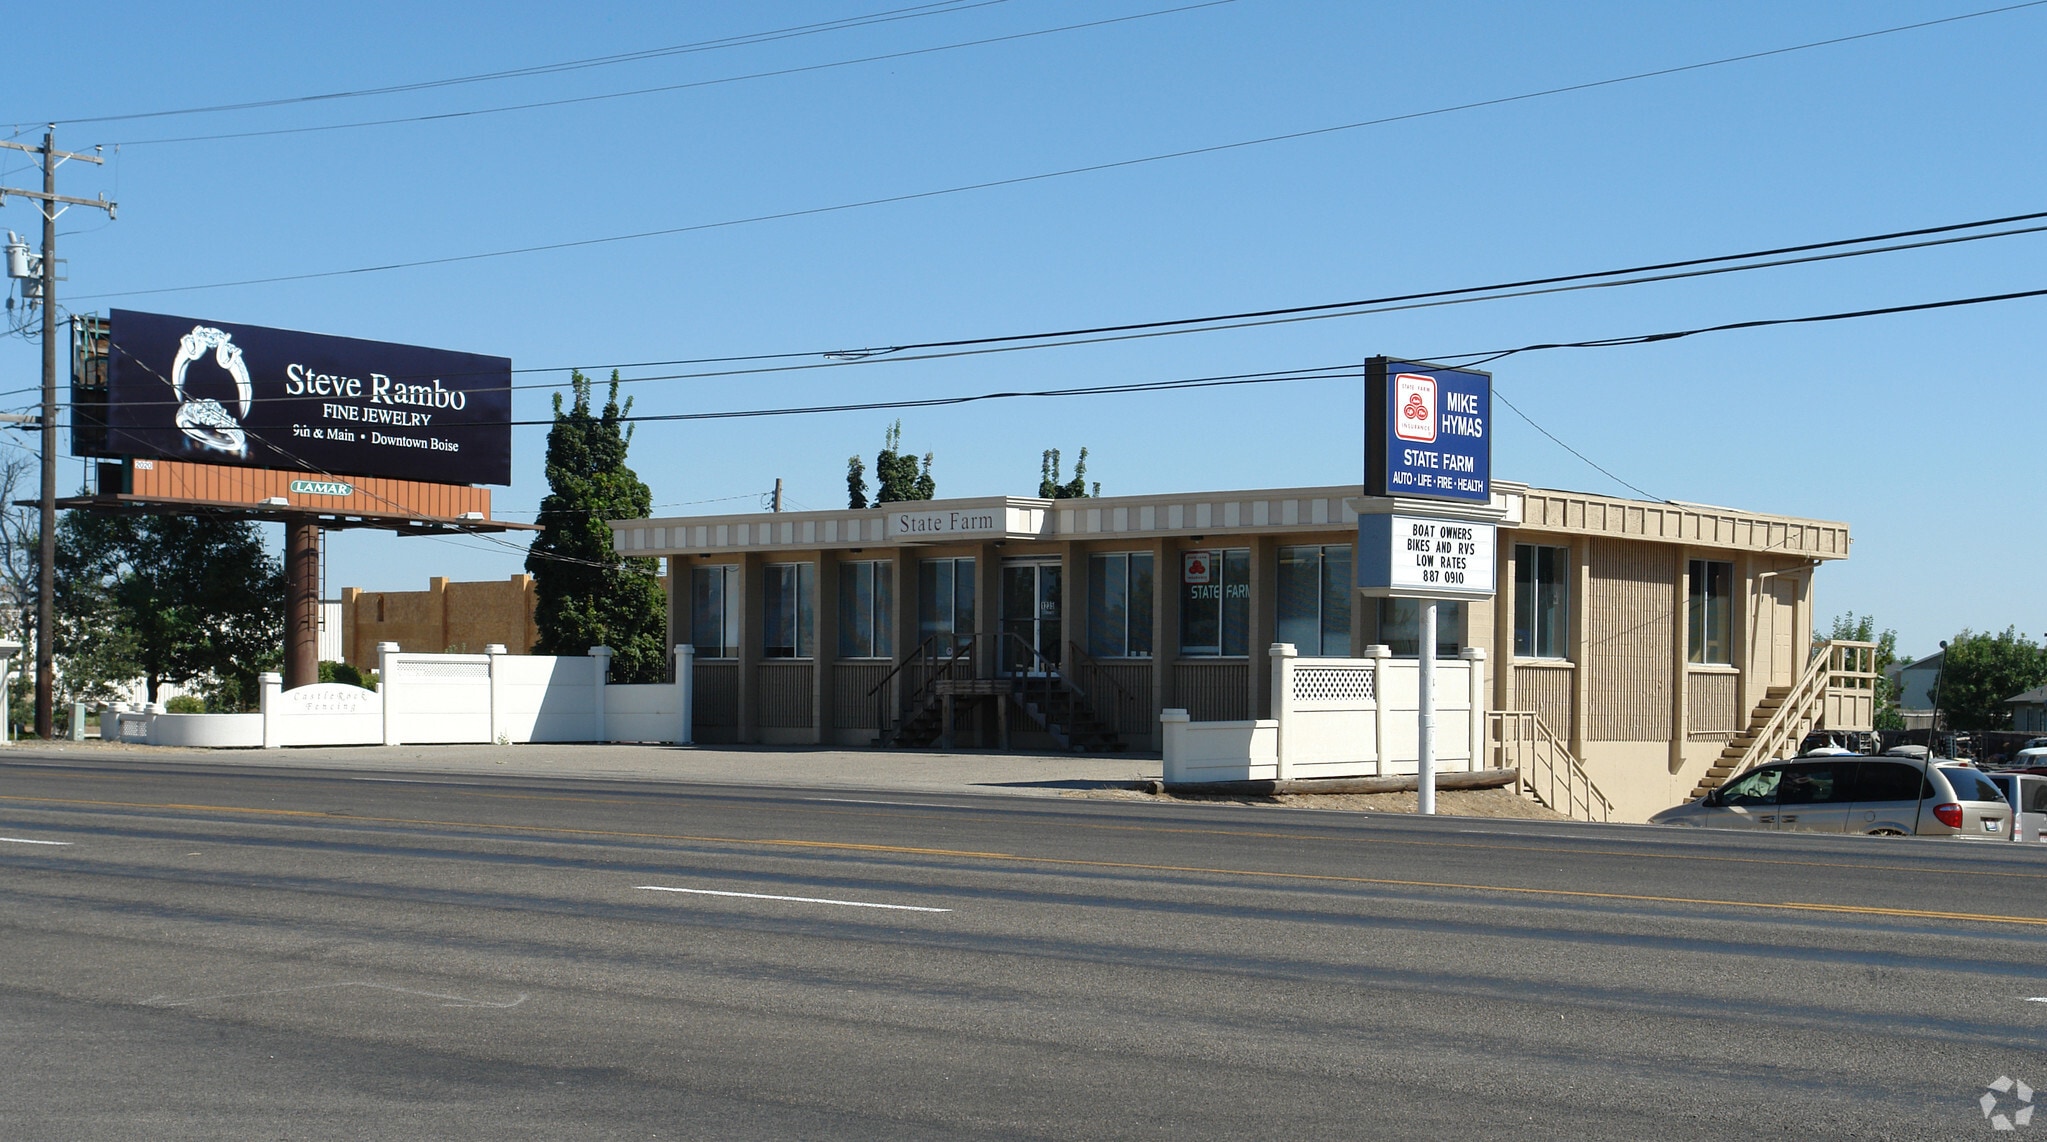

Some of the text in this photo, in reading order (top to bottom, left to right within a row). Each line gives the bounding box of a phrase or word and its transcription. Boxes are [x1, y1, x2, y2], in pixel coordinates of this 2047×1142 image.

[286, 363, 466, 411] Steve Rambo
[1447, 392, 1478, 414] MIKE
[323, 403, 432, 426] FINE JEWELRY
[1442, 414, 1483, 438] HYMAS
[313, 428, 324, 439] &
[326, 428, 355, 442] Main
[371, 432, 428, 449] Downtown
[430, 438, 459, 452] Boise
[1404, 449, 1474, 472] STATE FARM
[296, 482, 348, 494] LAMAR
[1392, 471, 1484, 492] AUTO LIFE FIRE HEALTH
[900, 512, 993, 533] State Farm
[1413, 523, 1472, 540] BOAT OWNERS
[1407, 538, 1475, 555] BIKES AND RVS
[1416, 554, 1466, 569] LOW RATES
[1423, 570, 1464, 584] 887 0910
[1191, 584, 1220, 599] STATE
[306, 702, 356, 712] Fencing
